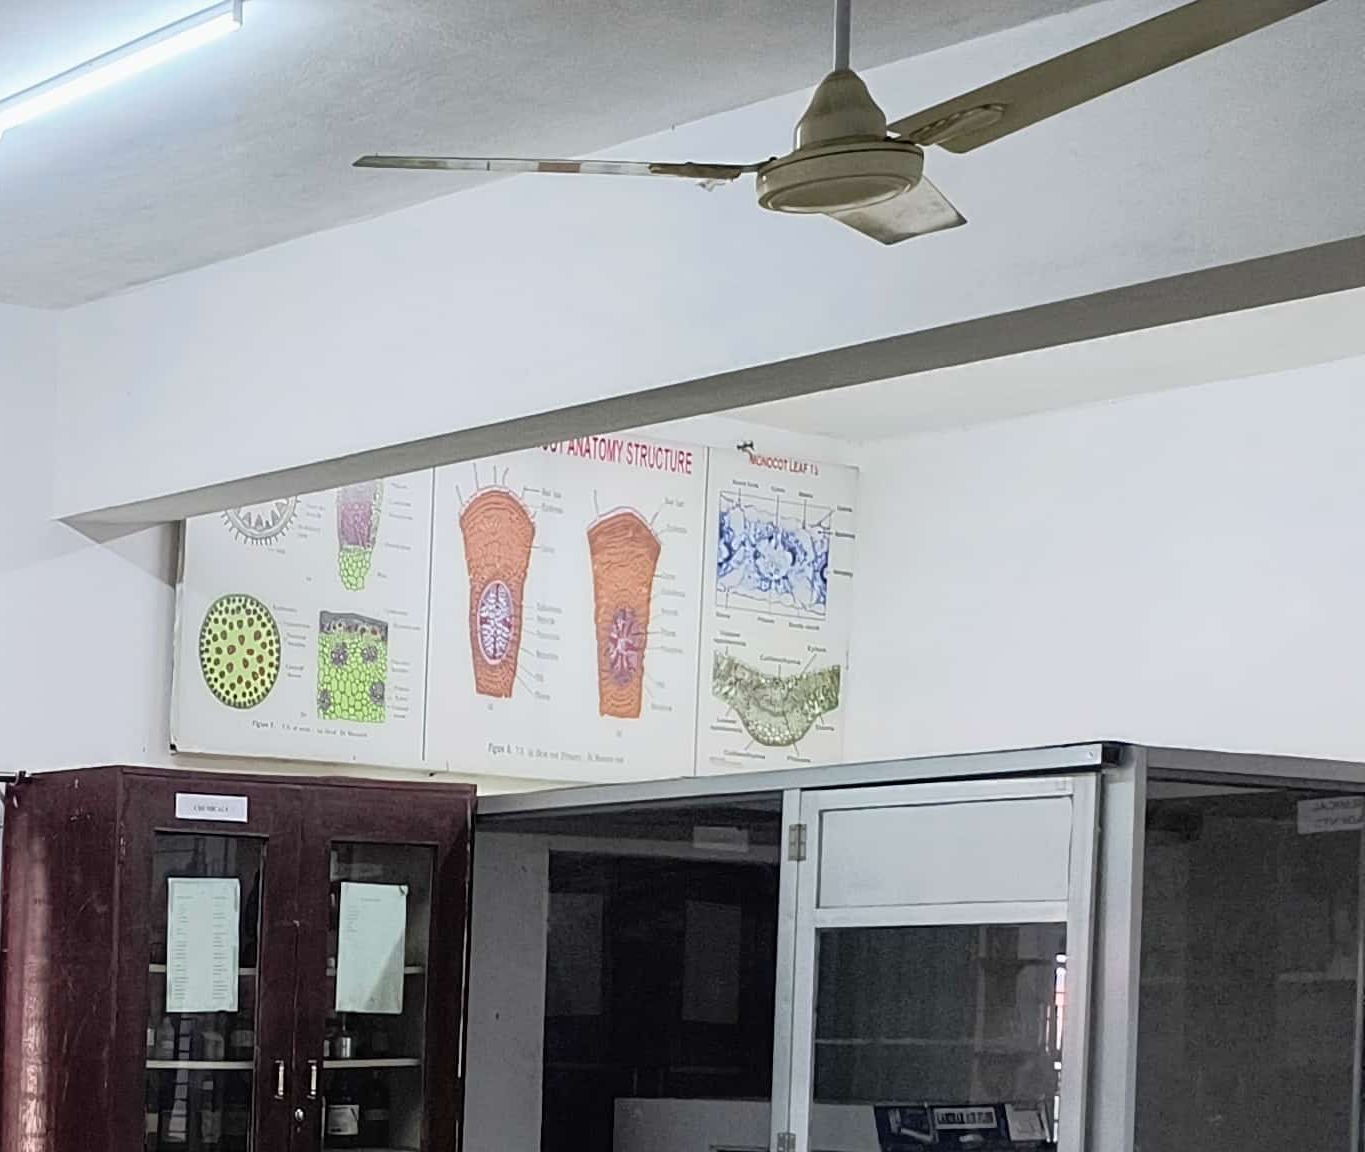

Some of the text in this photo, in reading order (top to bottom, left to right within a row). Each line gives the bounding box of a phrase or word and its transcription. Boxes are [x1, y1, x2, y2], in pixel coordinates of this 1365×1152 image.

[568, 437, 624, 464] ANATOMY
[626, 442, 693, 475] STRUCTURE
[789, 460, 808, 473] LEAF
